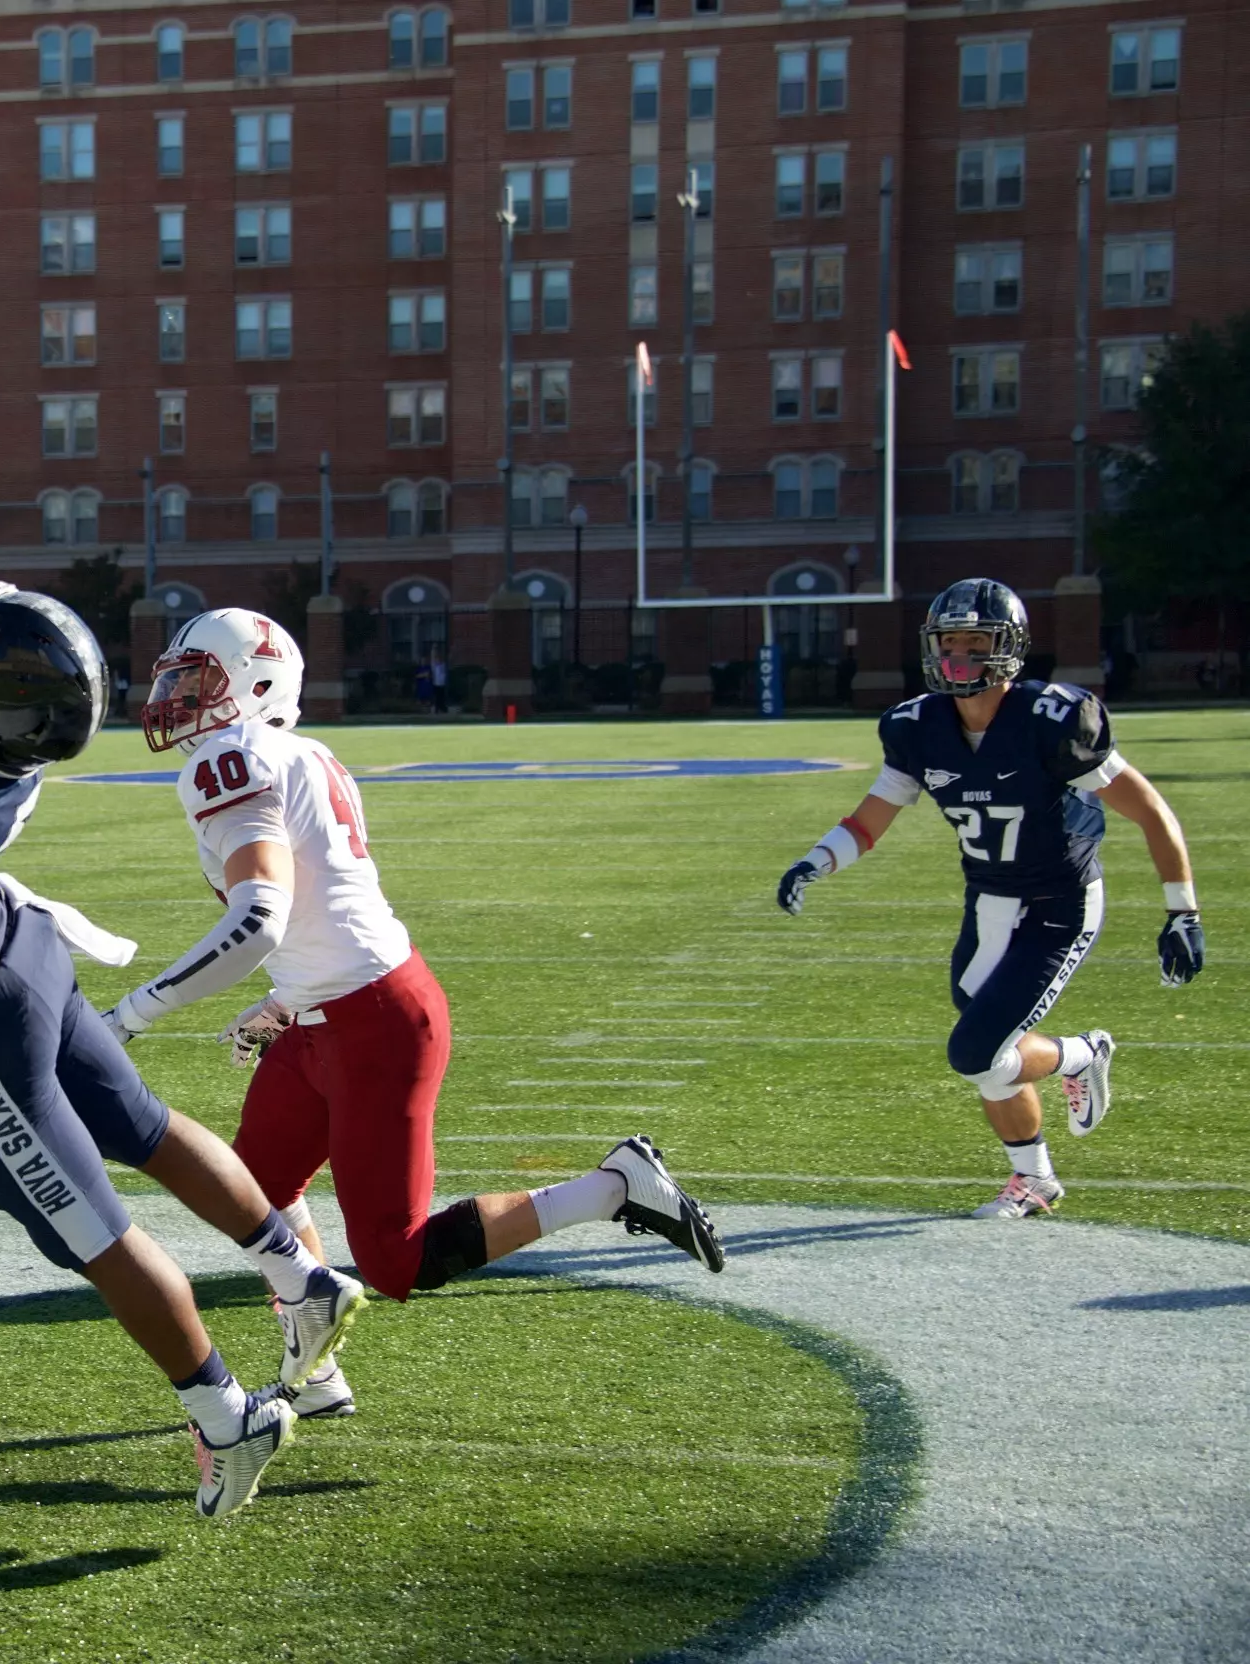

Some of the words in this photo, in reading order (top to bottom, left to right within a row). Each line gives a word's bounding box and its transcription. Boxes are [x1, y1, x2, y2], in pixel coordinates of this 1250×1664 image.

[250, 616, 285, 662] L
[760, 649, 773, 714] HOYAS
[1032, 683, 1079, 723] 27
[193, 750, 250, 801] 40
[962, 790, 992, 802] HOYAS
[944, 805, 1025, 862] 27
[1017, 987, 1059, 1033] HOYA
[1058, 930, 1096, 984] SAXA
[16, 1151, 78, 1217] HOYA
